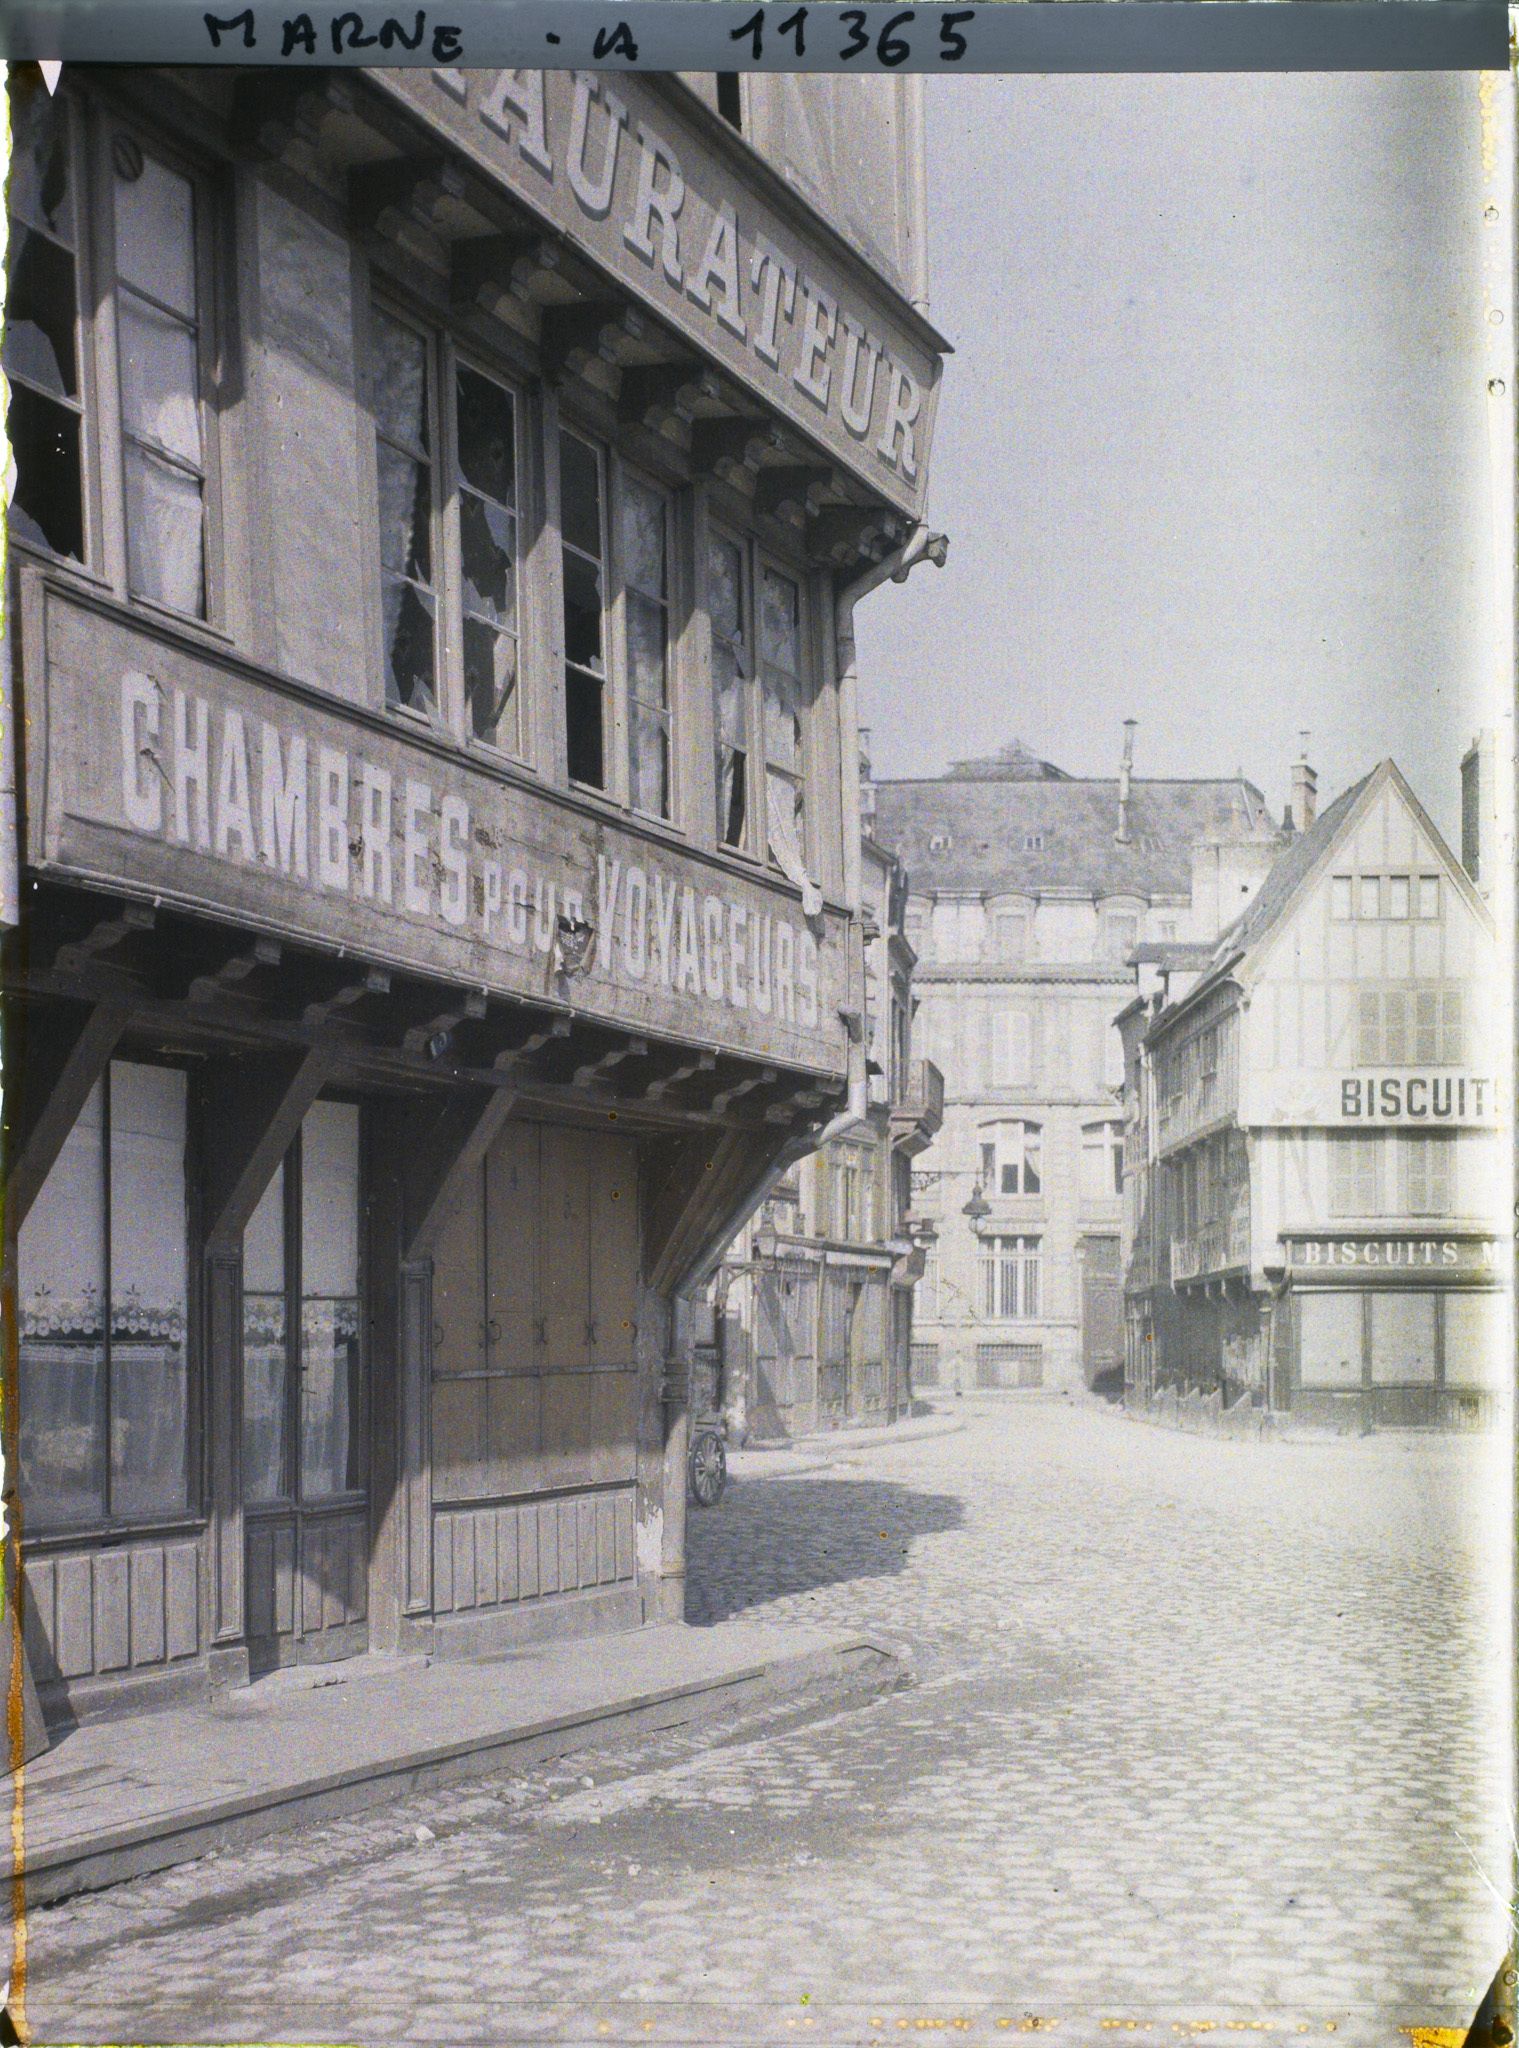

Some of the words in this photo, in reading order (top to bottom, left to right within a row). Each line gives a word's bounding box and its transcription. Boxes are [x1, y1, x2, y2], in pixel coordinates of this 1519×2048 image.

[203, 8, 463, 63] MARNE
[729, 6, 976, 67] 11365
[432, 68, 918, 487] AURATEUR
[121, 669, 470, 926] CHAMBRES
[598, 853, 818, 1030] VOYAGEURS
[1341, 1077, 1500, 1117] BISCUIT
[1304, 1240, 1459, 1266] BISCUITS
